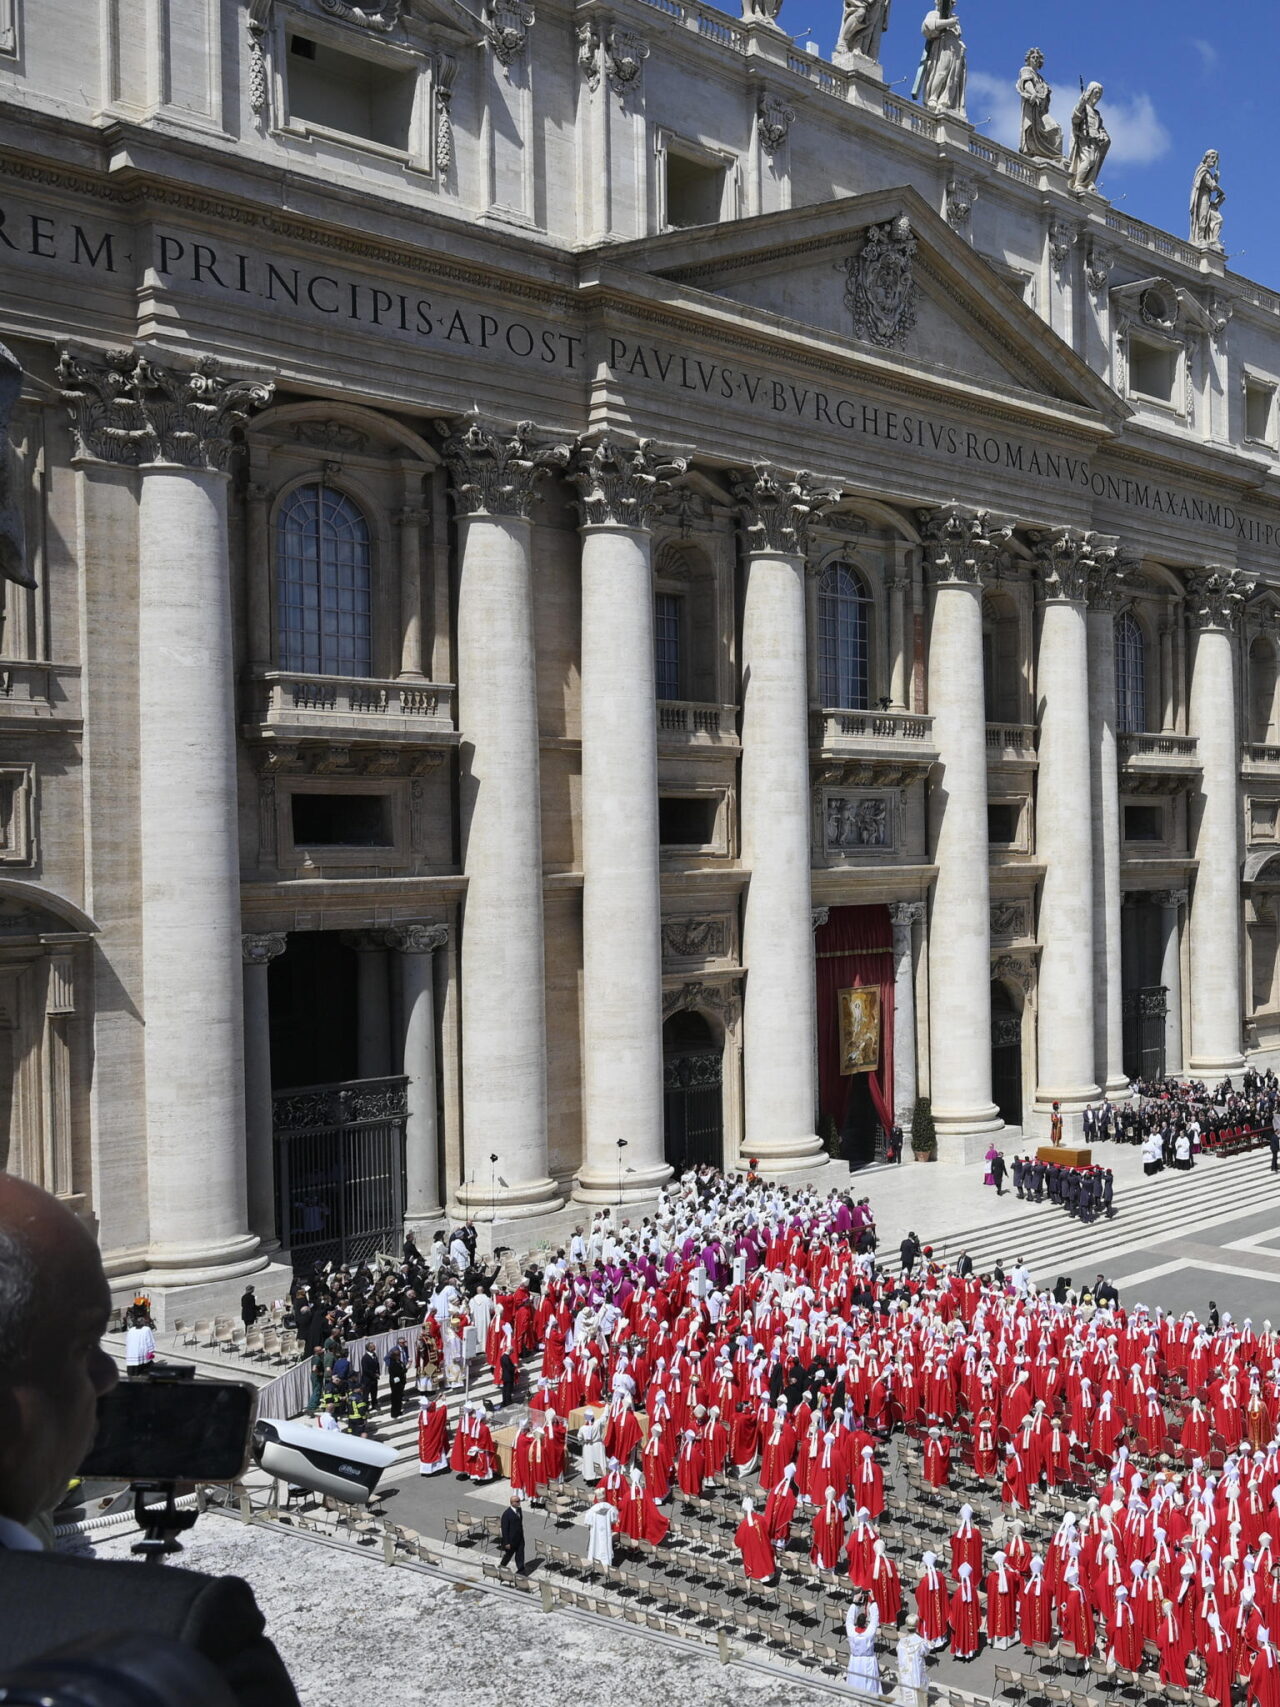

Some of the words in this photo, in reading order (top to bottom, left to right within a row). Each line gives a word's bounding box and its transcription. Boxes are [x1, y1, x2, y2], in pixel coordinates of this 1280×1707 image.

[156, 234, 433, 335] PRINCIPIS
[443, 309, 582, 368] APOST
[609, 336, 734, 399] PAVLVS
[741, 372, 762, 404] V
[770, 380, 958, 455] BVRGHESIVS
[966, 432, 1089, 486] ROMANVS
[1090, 472, 1134, 504] ONT
[1135, 483, 1177, 515] MAX
[1179, 497, 1204, 522] AN
